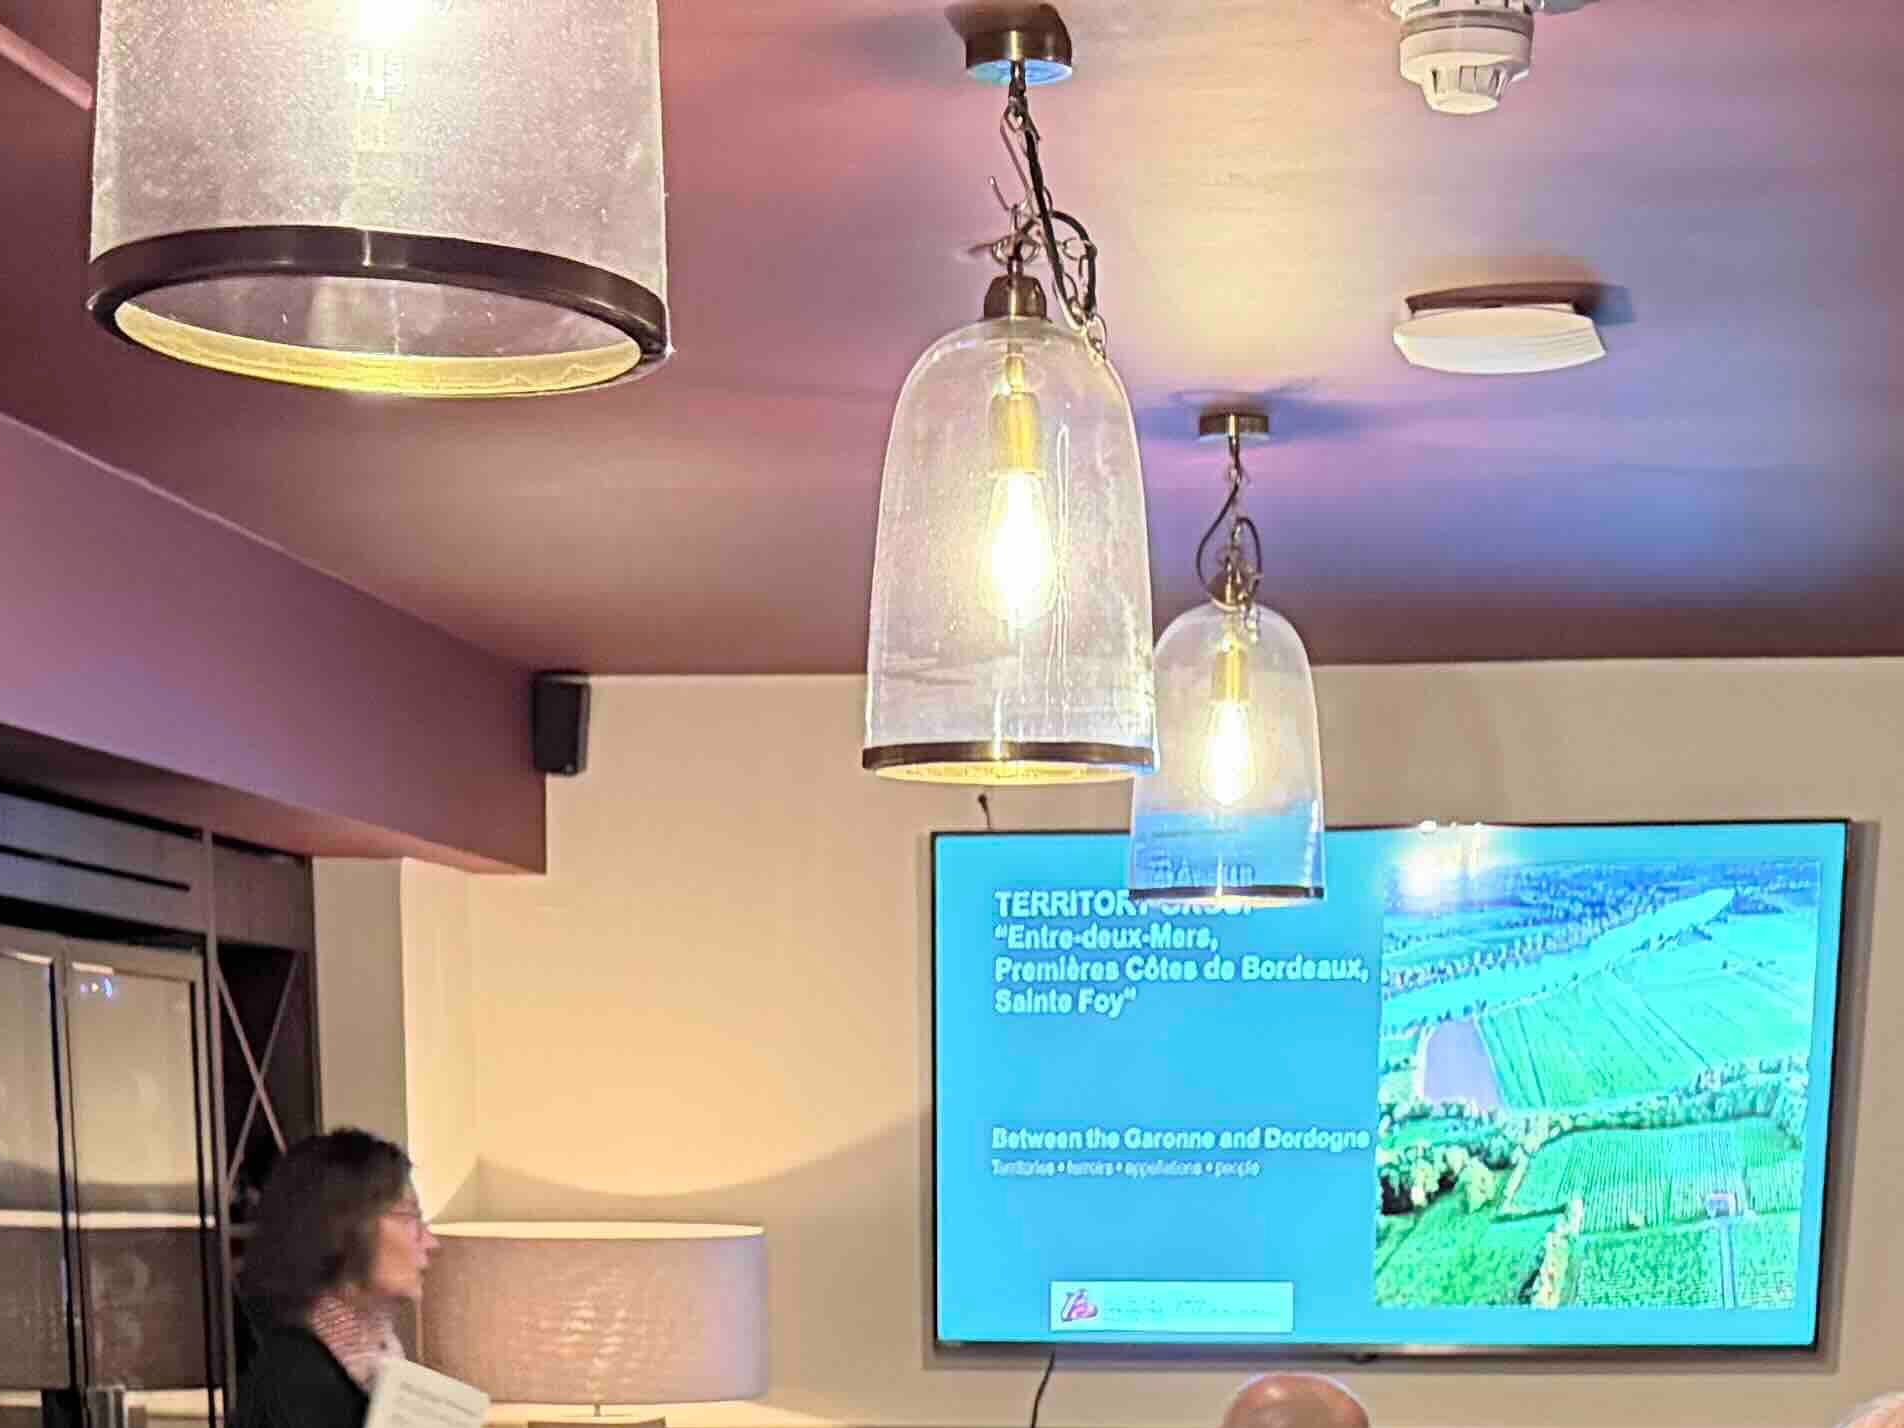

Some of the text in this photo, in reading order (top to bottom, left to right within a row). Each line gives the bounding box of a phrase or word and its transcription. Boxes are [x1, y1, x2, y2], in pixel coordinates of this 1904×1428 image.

[996, 955, 1369, 984] Premières Côtes de Bordeaux,
[996, 989, 1073, 1014] Sainte
[992, 1127, 1371, 1153] Between the Garonne and Dordogne
